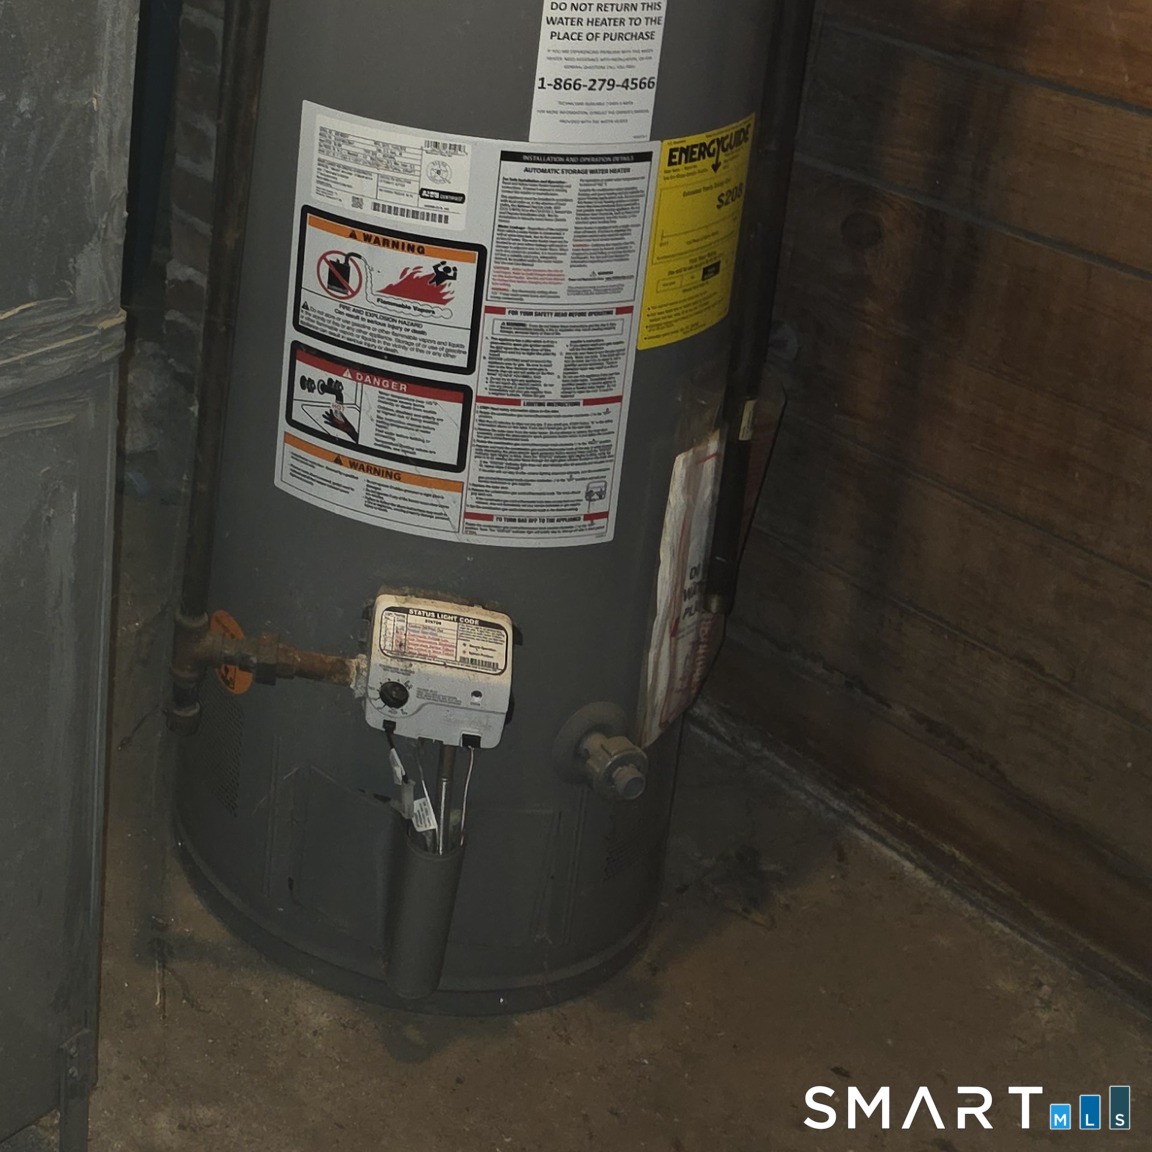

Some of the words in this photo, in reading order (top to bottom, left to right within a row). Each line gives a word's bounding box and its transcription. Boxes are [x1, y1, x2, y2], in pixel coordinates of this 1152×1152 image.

[551, 2, 567, 11] DO
[570, 2, 594, 12] NOT
[596, 3, 637, 12] RETURN
[640, 2, 662, 11] THIS
[546, 16, 584, 26] WATER
[587, 17, 626, 27] HEATER
[628, 17, 642, 26] TO
[644, 16, 663, 26] THE
[550, 31, 583, 41] PLACE
[586, 32, 600, 41] OF
[603, 30, 656, 41] PURCHASE
[538, 77, 655, 91] 1-866-279-4566
[363, 232, 425, 254] WARNING
[377, 298, 411, 310] Flammable
[413, 305, 435, 314] Vapors
[356, 372, 407, 392] DANGER
[349, 460, 401, 481] WARNING
[409, 609, 436, 618] STATUS
[437, 613, 458, 621] LIGHT
[459, 618, 479, 626] CODE
